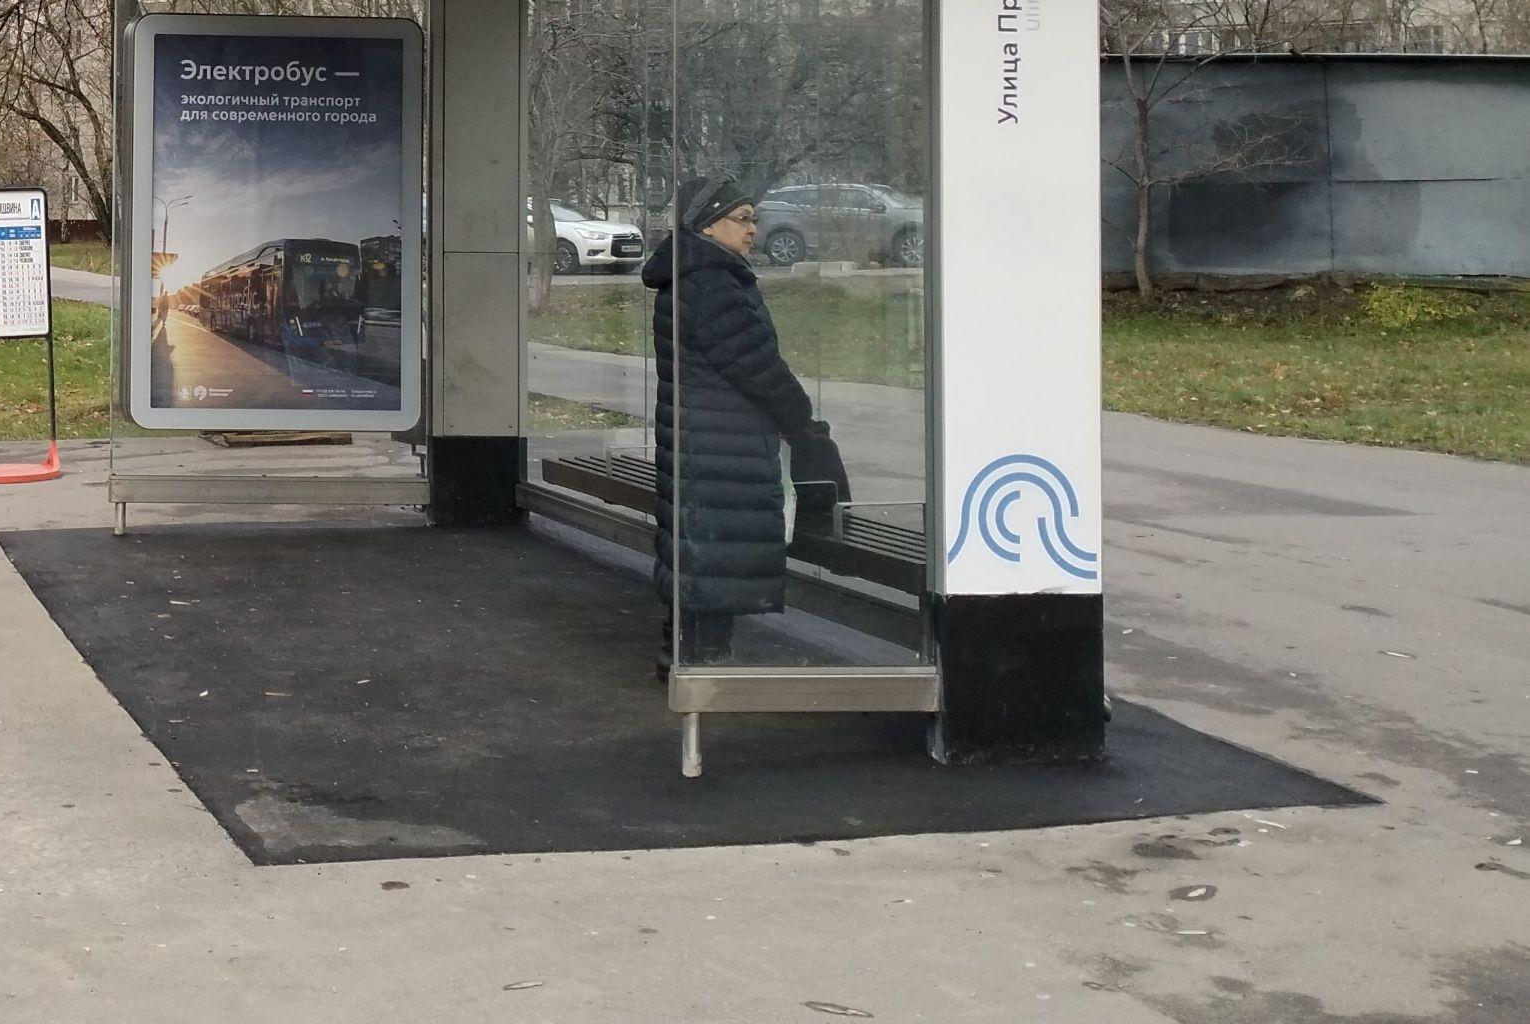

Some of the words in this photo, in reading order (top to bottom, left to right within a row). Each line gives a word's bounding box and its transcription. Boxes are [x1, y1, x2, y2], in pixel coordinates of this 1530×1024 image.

[179, 59, 328, 86] Электробус
[997, 42, 1021, 125] Улица
[180, 93, 280, 107] экологичный
[283, 96, 361, 109] транспорт
[179, 109, 208, 122] для
[211, 111, 321, 123] современного
[324, 113, 377, 124] города
